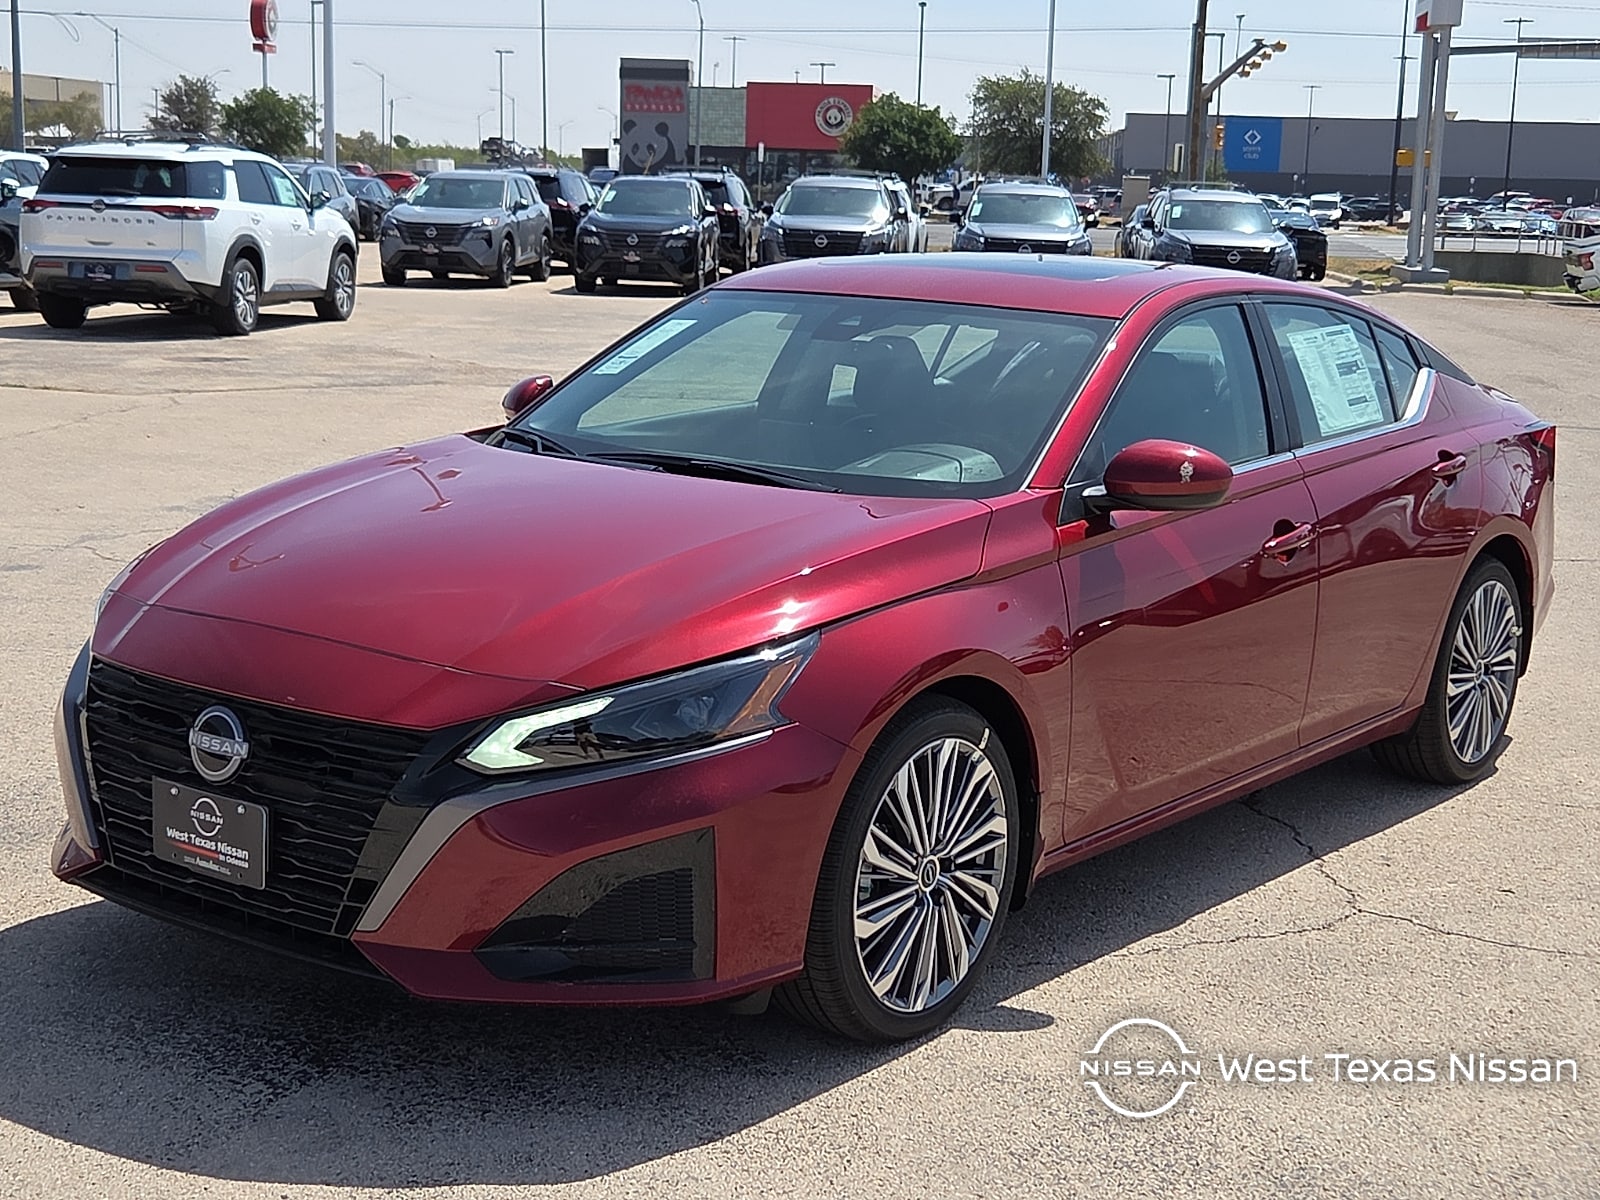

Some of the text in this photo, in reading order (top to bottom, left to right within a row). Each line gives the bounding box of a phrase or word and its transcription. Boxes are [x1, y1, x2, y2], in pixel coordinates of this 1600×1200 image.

[46, 214, 155, 225] PATHFINDER
[190, 730, 248, 757] NISSAN
[190, 809, 223, 825] NISSAN
[166, 826, 249, 860] West Texas Nissan
